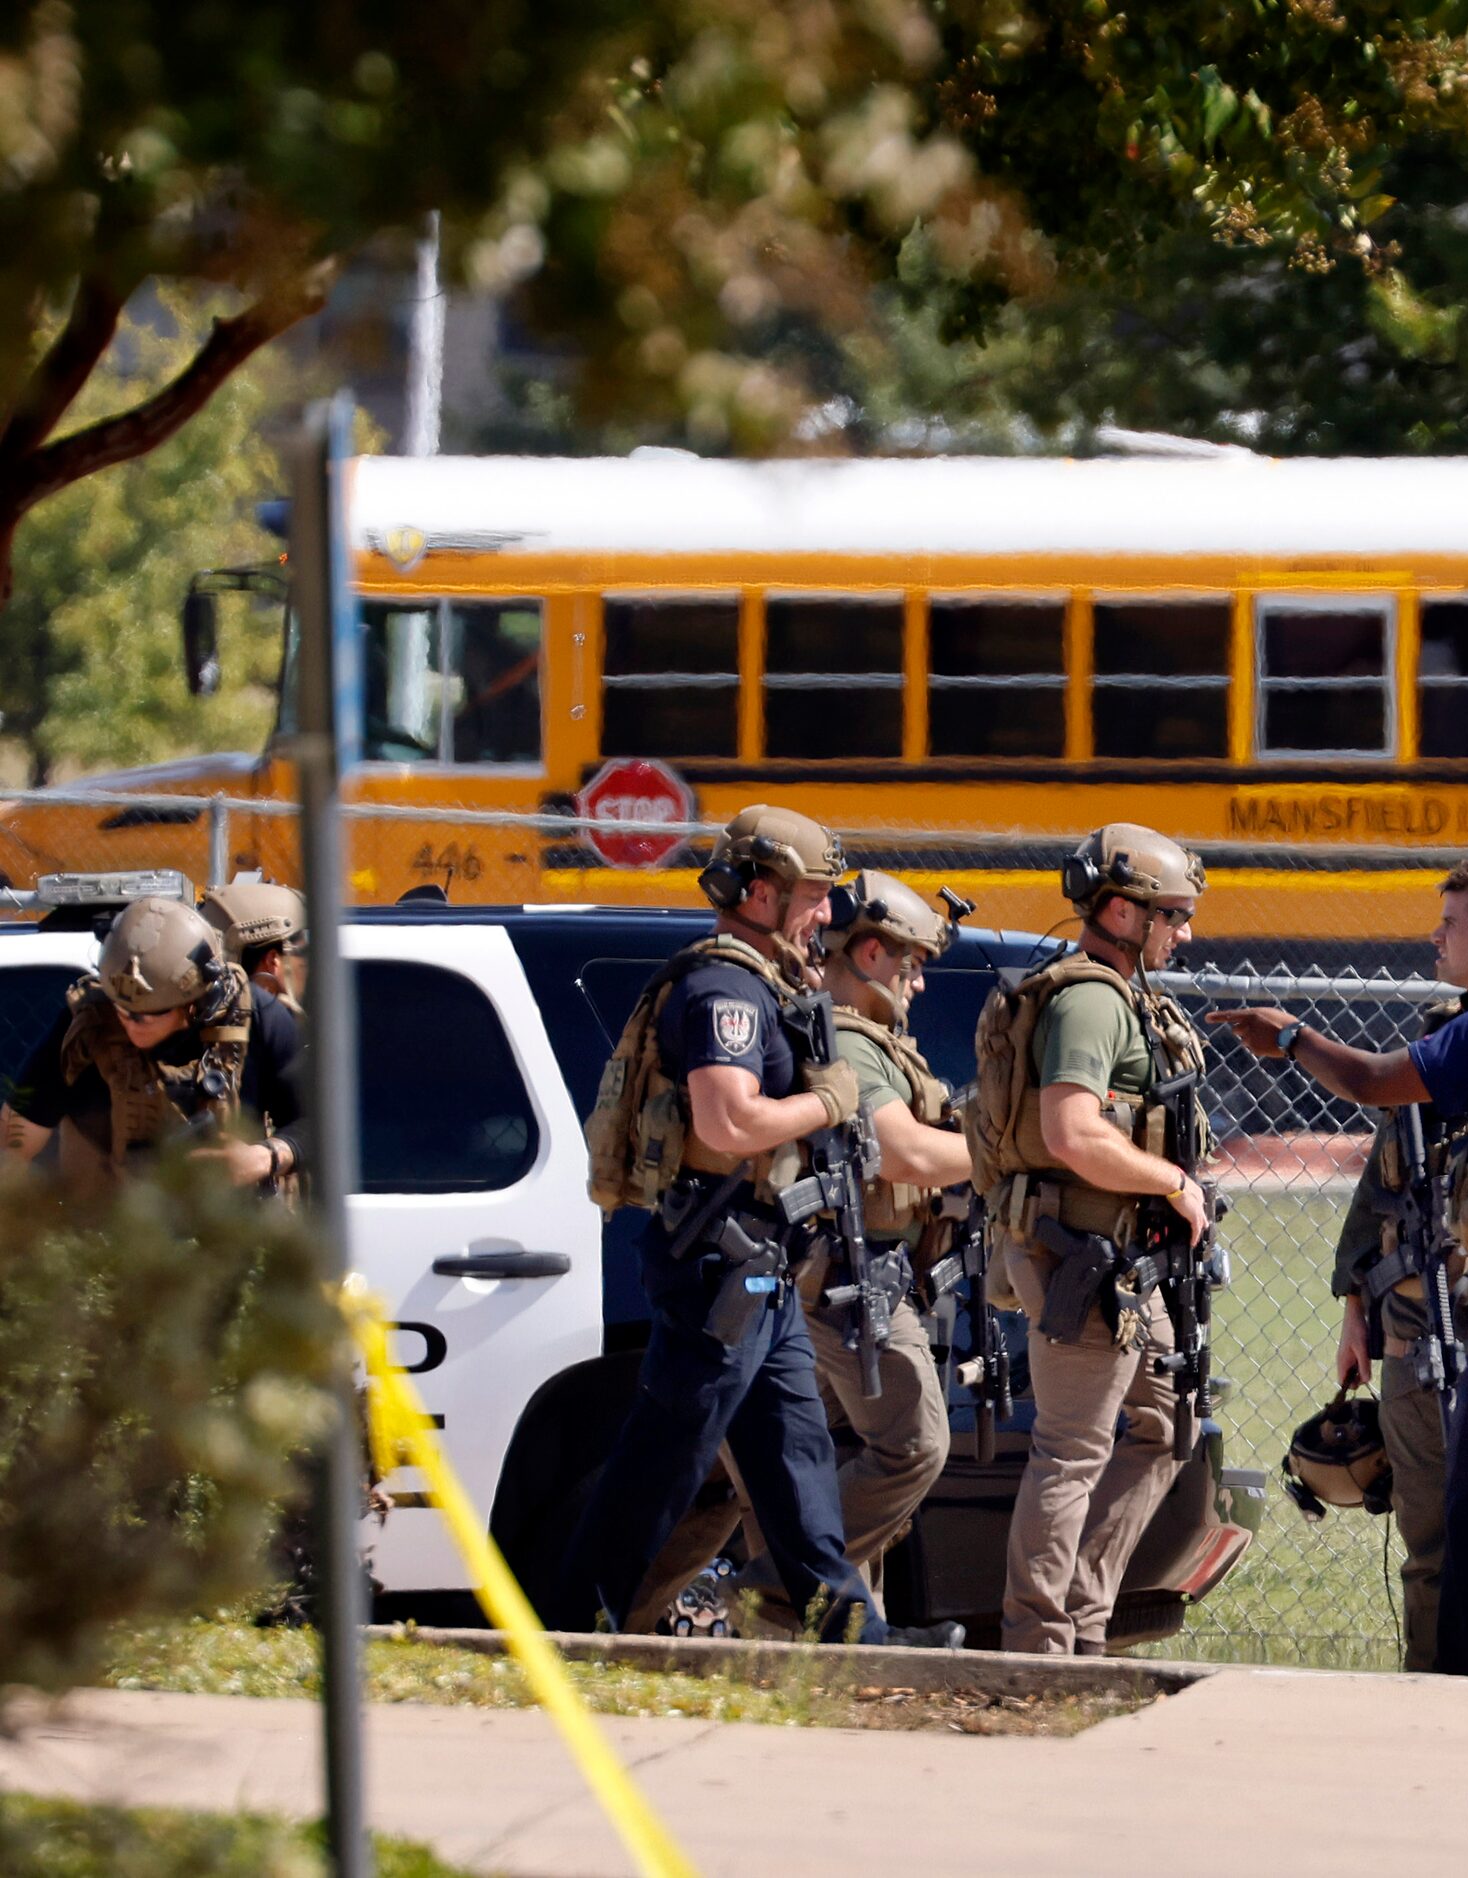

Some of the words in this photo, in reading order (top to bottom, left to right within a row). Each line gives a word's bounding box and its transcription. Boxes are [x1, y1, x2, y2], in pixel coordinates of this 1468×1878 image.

[595, 797, 677, 838] STOP
[1230, 797, 1448, 836] MANSFIELD
[411, 841, 480, 882] 446
